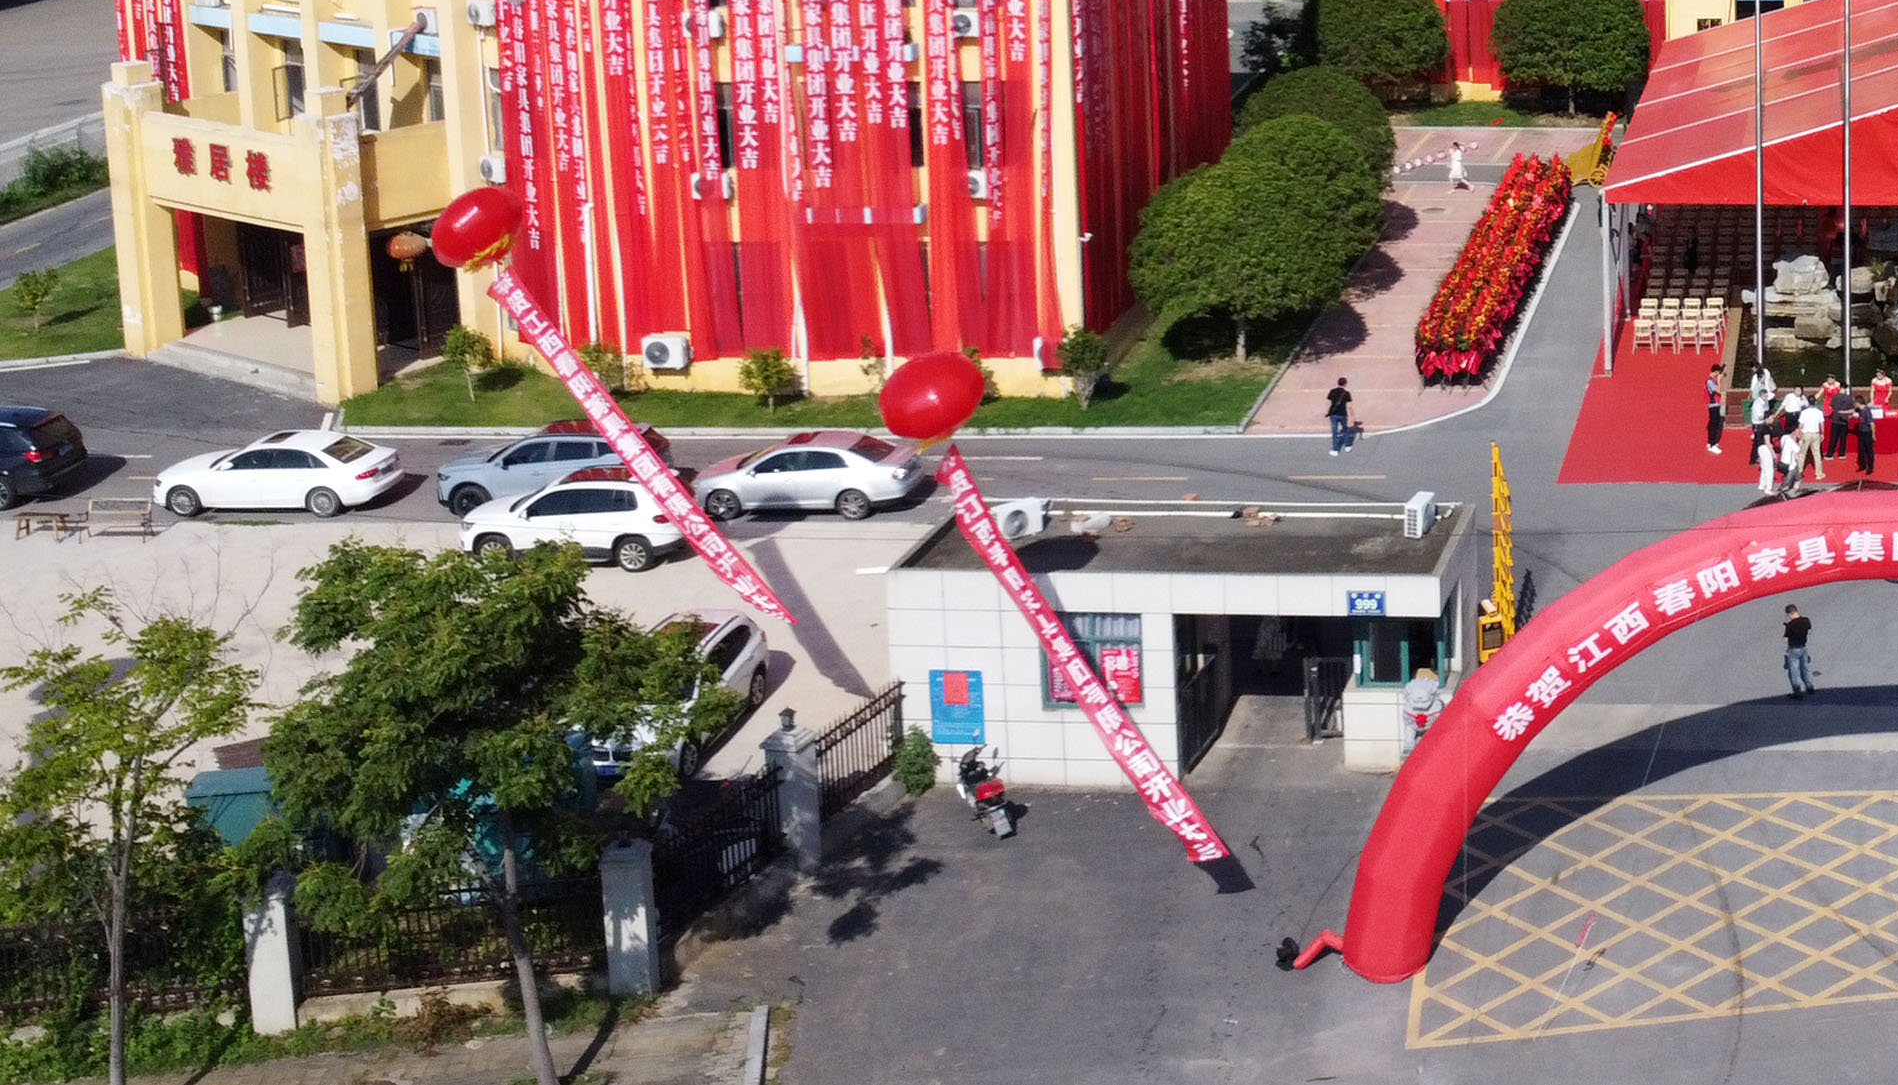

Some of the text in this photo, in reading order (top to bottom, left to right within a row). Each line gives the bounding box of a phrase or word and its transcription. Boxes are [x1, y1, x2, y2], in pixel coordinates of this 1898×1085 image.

[173, 136, 273, 192] 雅居楼
[493, 272, 785, 622] 恭贺江西春阳家具集团有限公司开业大
[1355, 598, 1378, 610] 999
